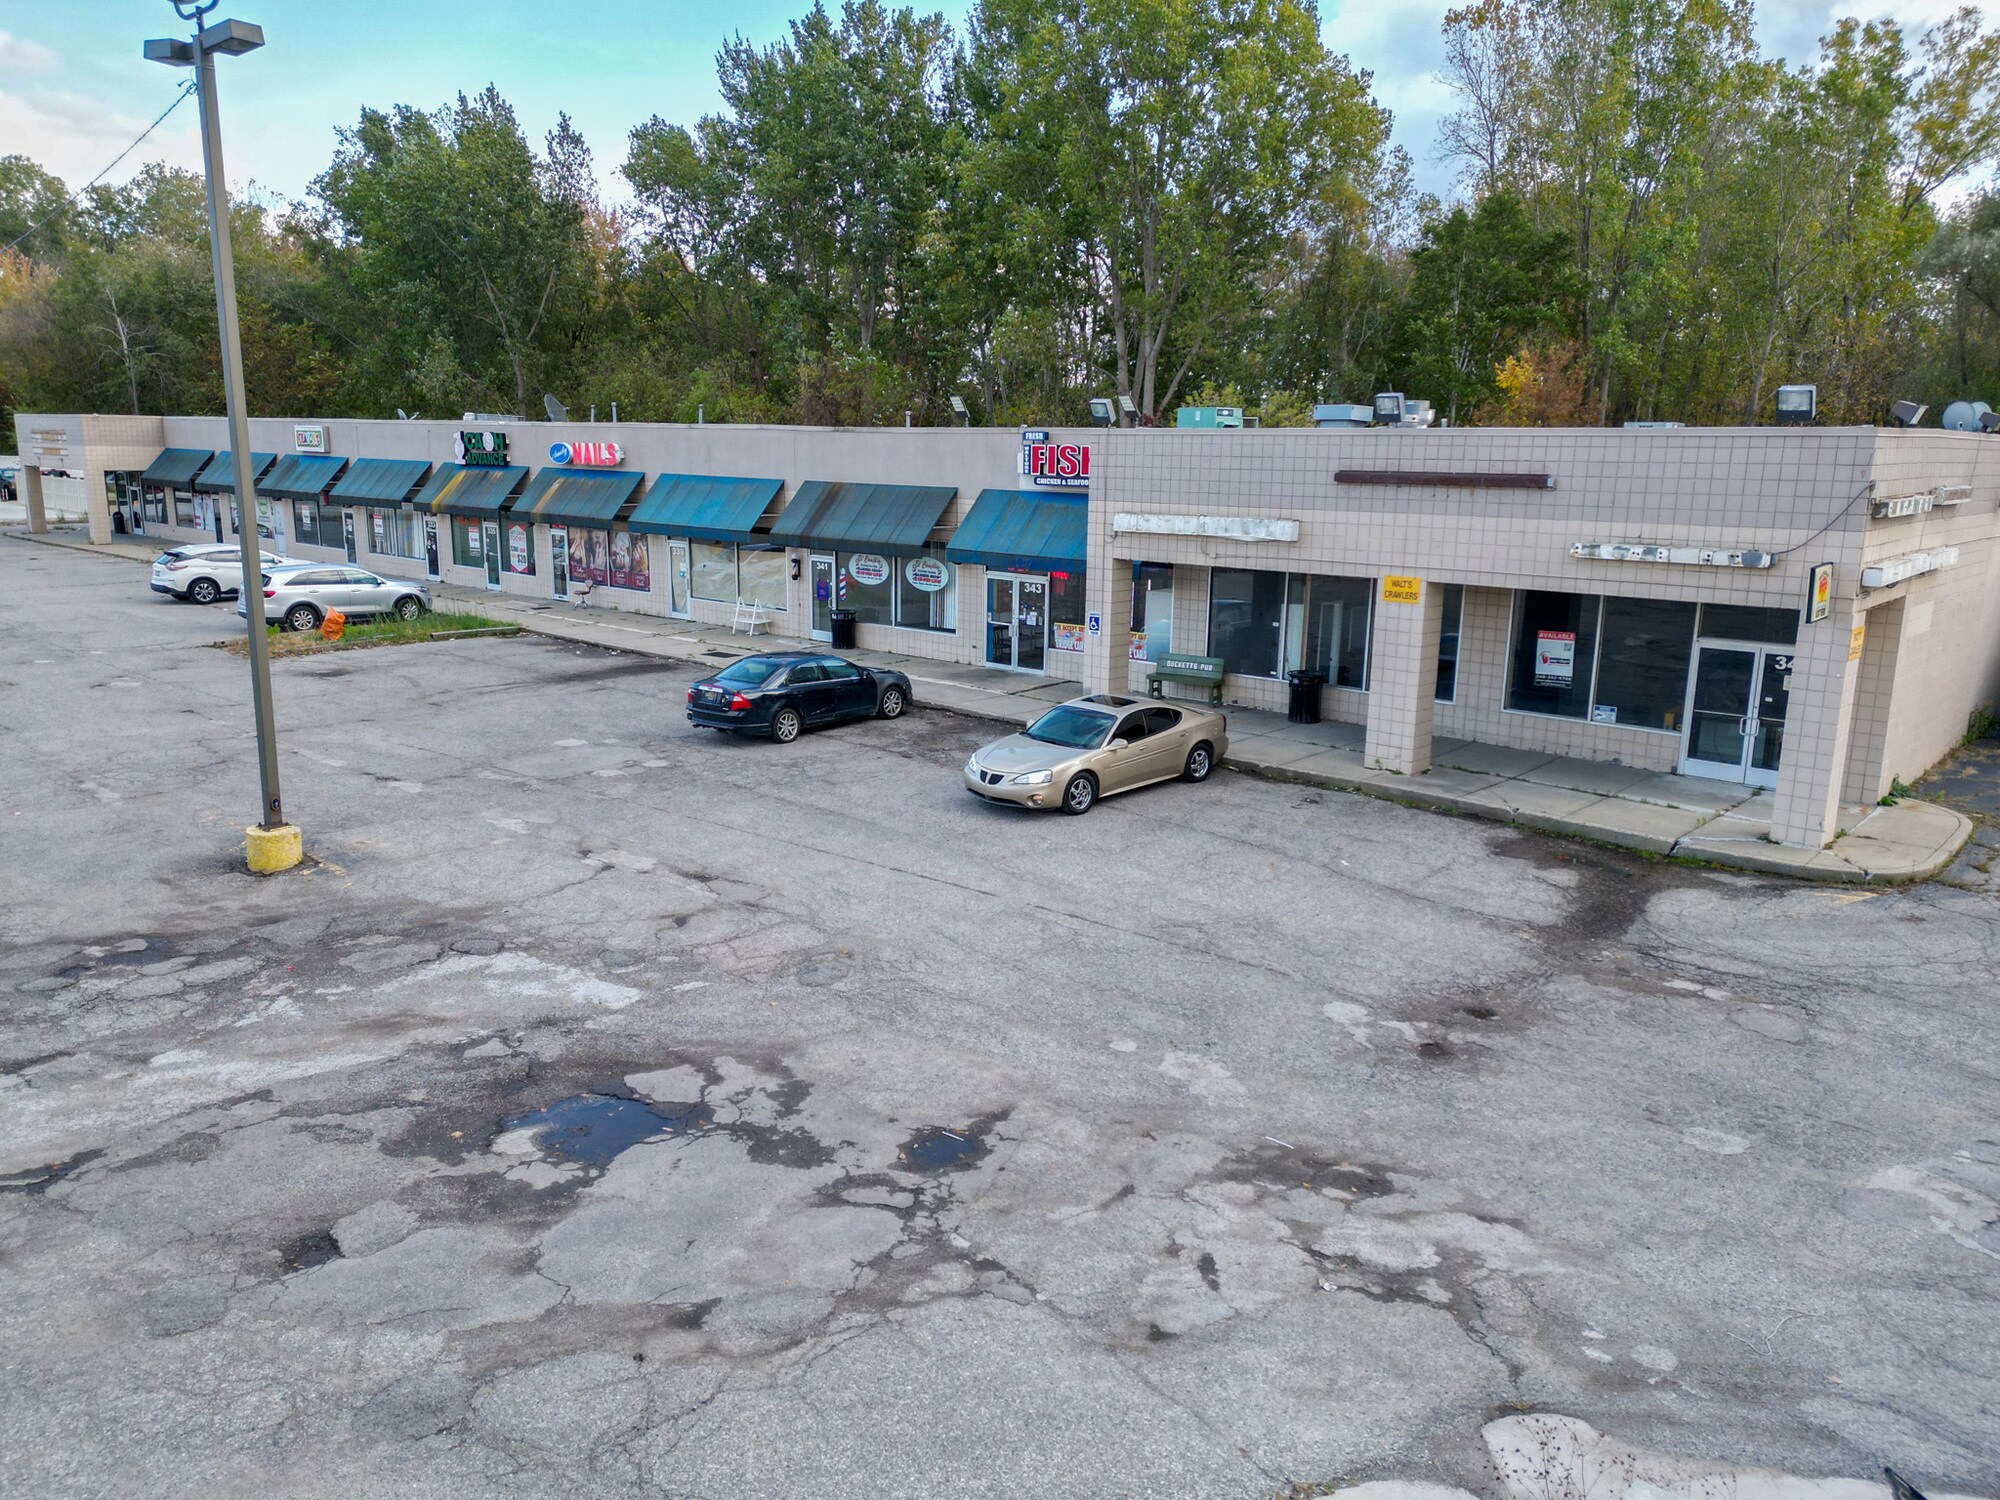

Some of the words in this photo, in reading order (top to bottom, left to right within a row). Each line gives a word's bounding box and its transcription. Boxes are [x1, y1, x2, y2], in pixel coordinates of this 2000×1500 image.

[1025, 432, 1044, 440] FRESH
[466, 452, 505, 466] ADVANCE
[572, 442, 617, 467] NAILS
[1036, 477, 1061, 485] CHICKEN
[816, 562, 828, 570] 341
[1024, 583, 1042, 594] 343
[1392, 580, 1413, 589] WALT'S
[1384, 589, 1419, 600] CRAWLERS
[1538, 631, 1574, 640] AVAILABLE
[1074, 641, 1085, 651] CAR
